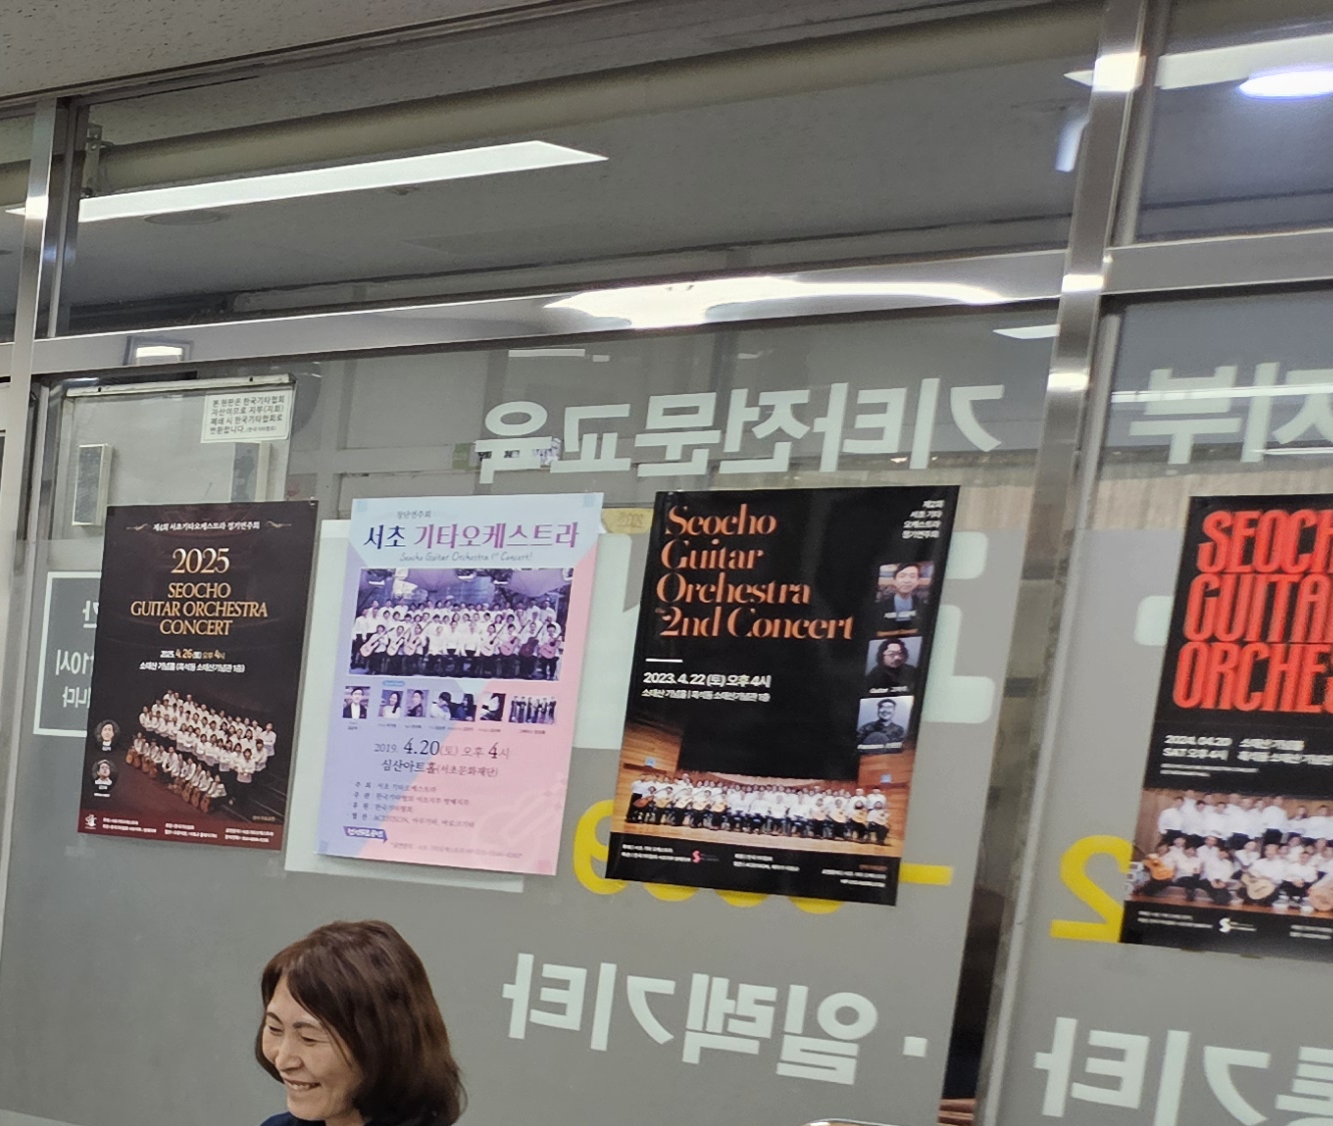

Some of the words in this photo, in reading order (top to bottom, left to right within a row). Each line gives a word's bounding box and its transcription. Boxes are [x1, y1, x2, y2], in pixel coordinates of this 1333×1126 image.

[665, 503, 777, 535] Seocho
[363, 523, 406, 549] 서초
[414, 522, 580, 549] 기타오케스트라
[1197, 508, 1333, 574] SEOCH
[171, 548, 230, 573] 2025
[425, 552, 450, 561] Guitar
[660, 538, 764, 569] Guitar
[168, 582, 231, 599] SEOCHO
[656, 571, 811, 605] Orchestra
[130, 600, 180, 617] GUITAR
[183, 601, 268, 618] ORCHESTRA
[1184, 573, 1333, 643] GUITA
[159, 619, 233, 635] CONCERT
[660, 606, 723, 637] 2nd
[727, 606, 854, 640] Concert
[461, 746, 484, 757] 오후
[488, 742, 510, 759] 4시
